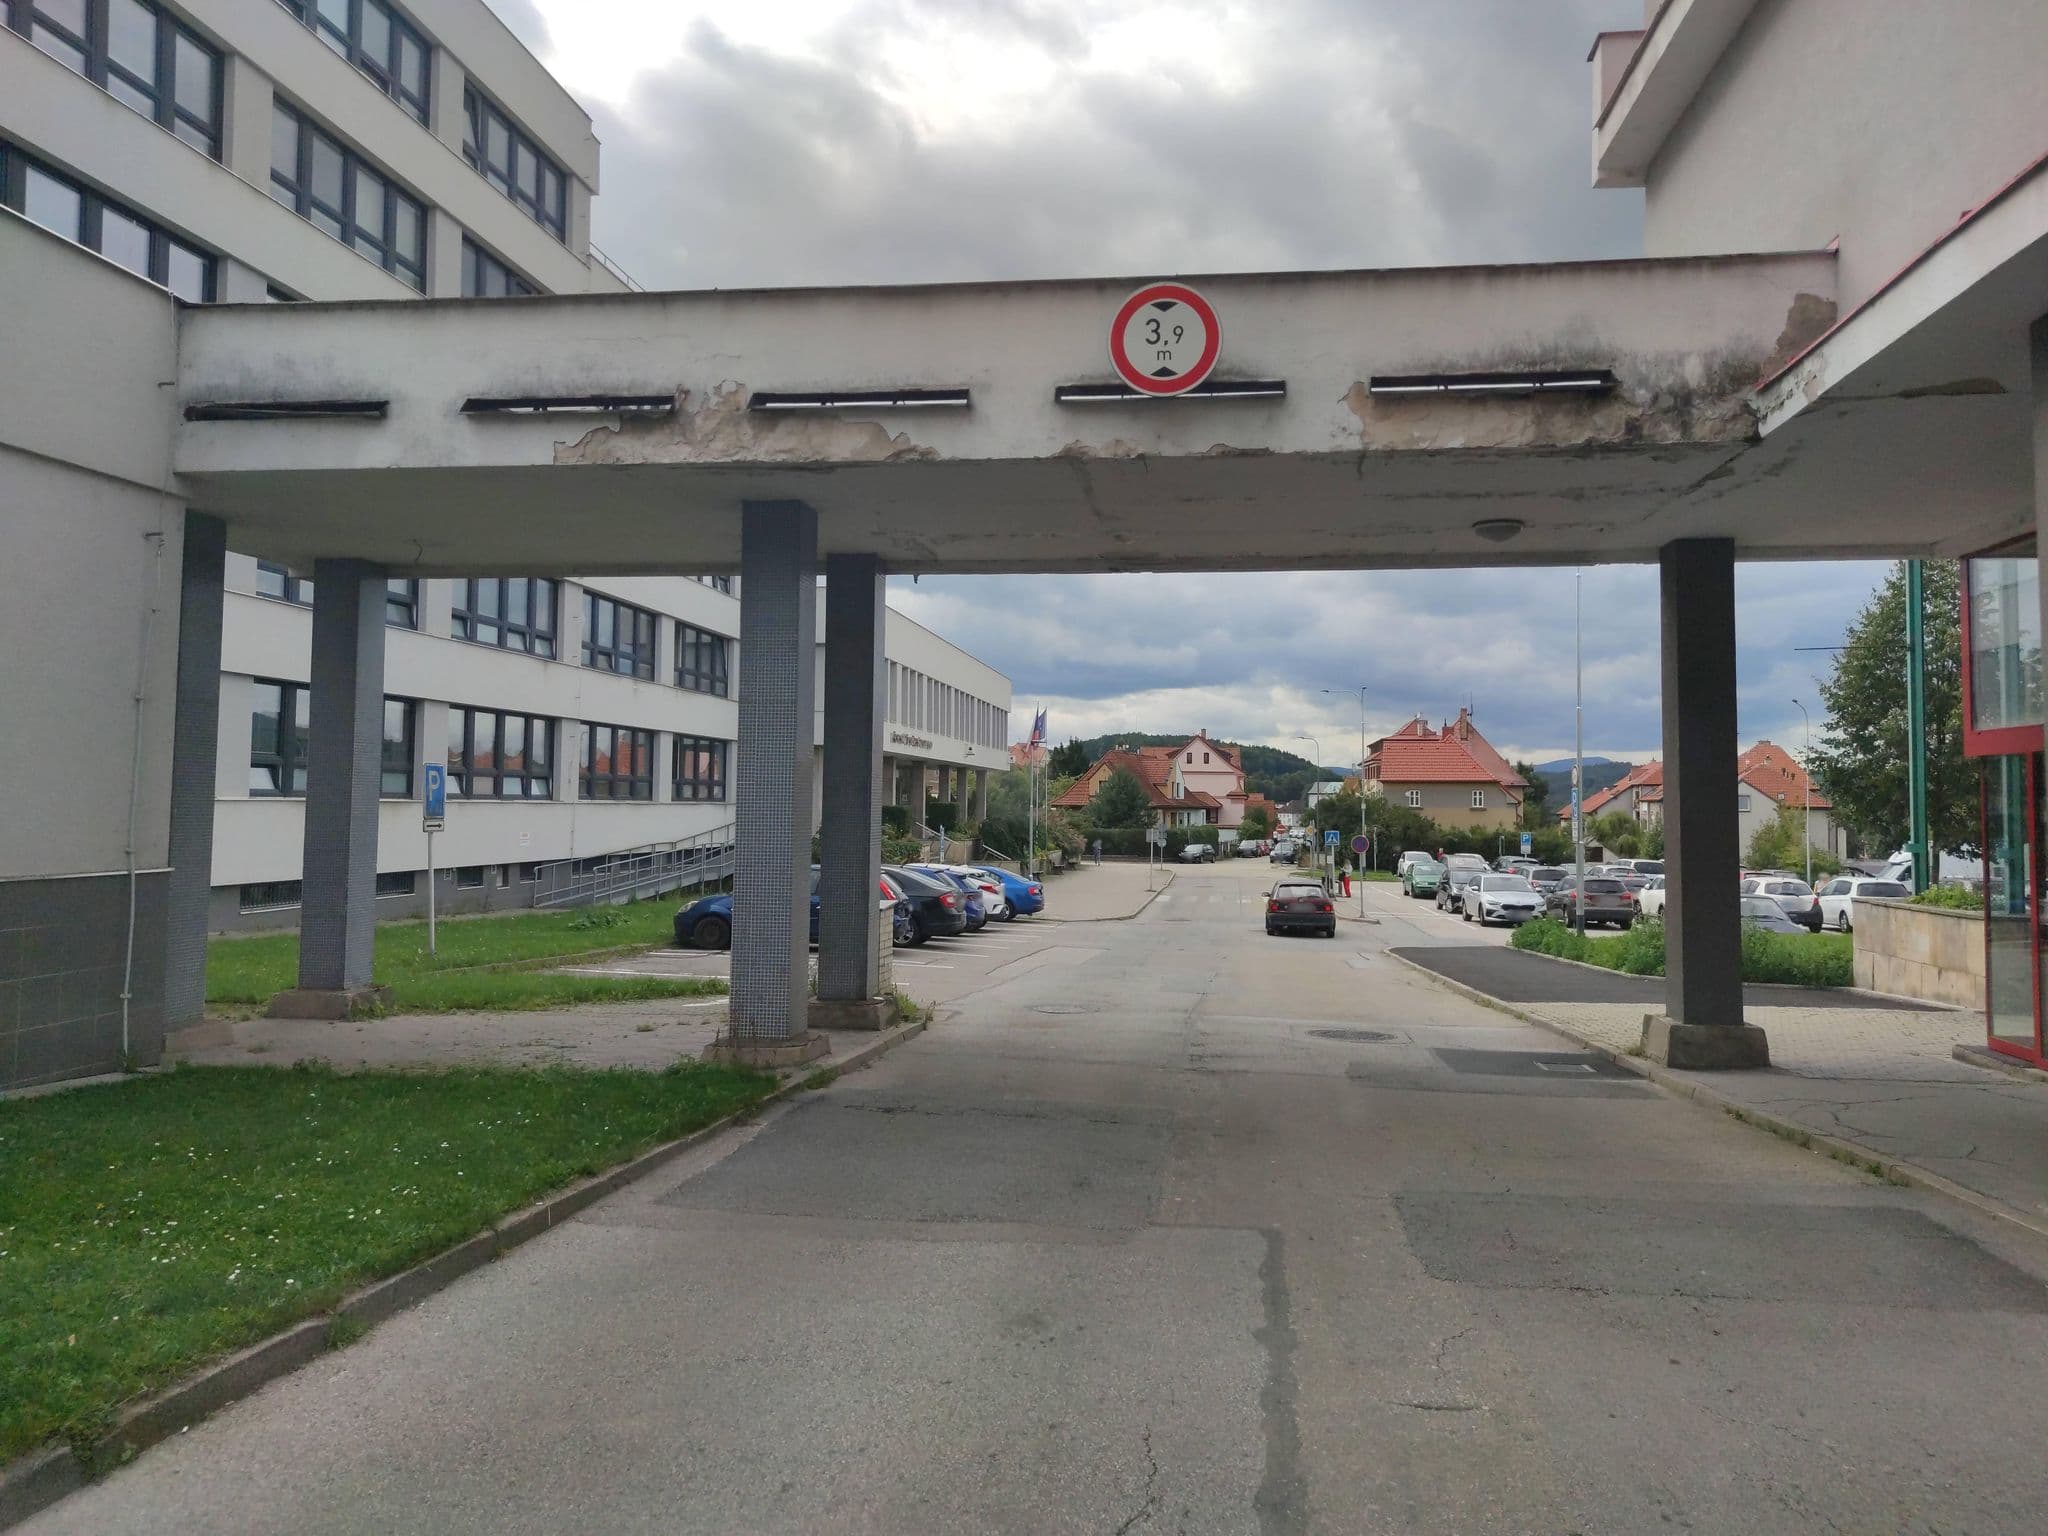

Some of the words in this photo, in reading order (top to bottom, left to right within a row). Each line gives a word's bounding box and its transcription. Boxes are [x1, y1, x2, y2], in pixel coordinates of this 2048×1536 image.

[1145, 318, 1184, 346] 3,9
[1157, 350, 1172, 360] m
[428, 770, 441, 801] P
